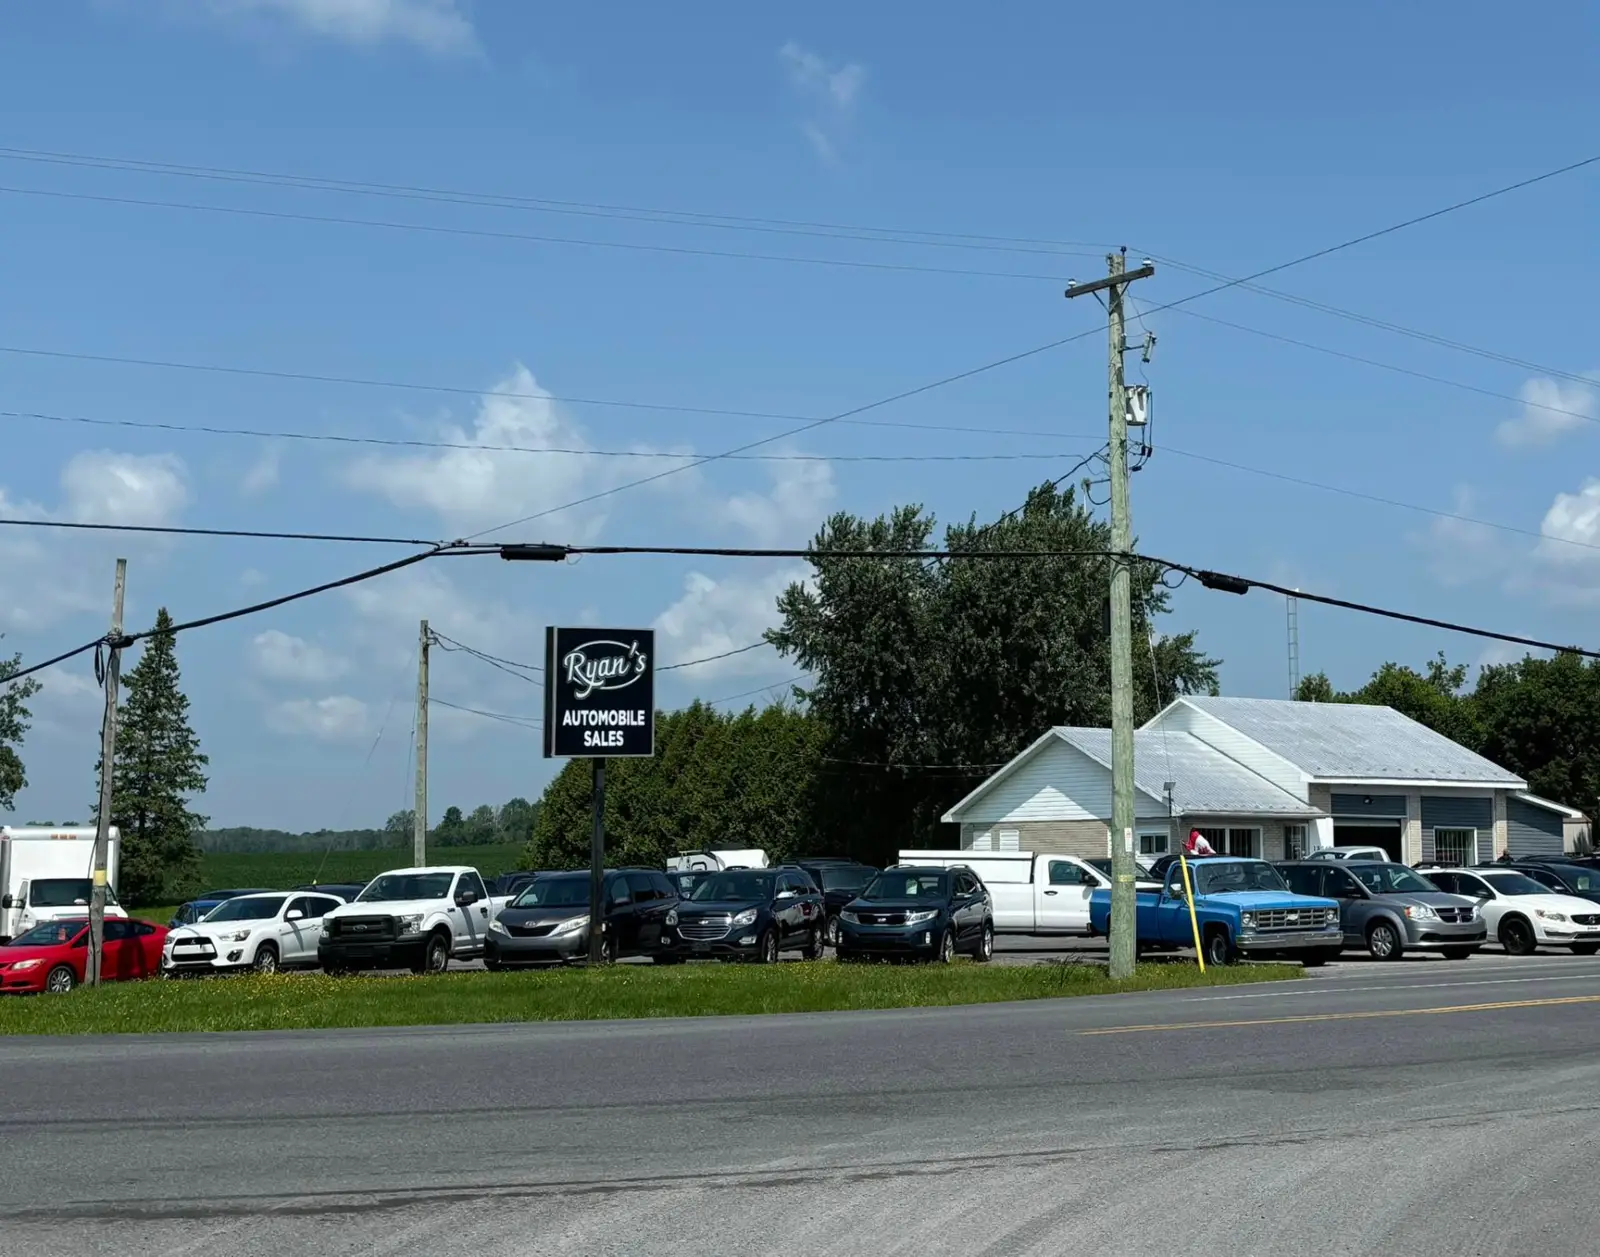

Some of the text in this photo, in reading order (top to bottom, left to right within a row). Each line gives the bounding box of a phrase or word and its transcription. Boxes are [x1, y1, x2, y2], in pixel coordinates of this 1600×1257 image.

[563, 640, 647, 699] Ryan's
[562, 709, 646, 727] AUTOMOBILE
[583, 730, 625, 747] SALES
